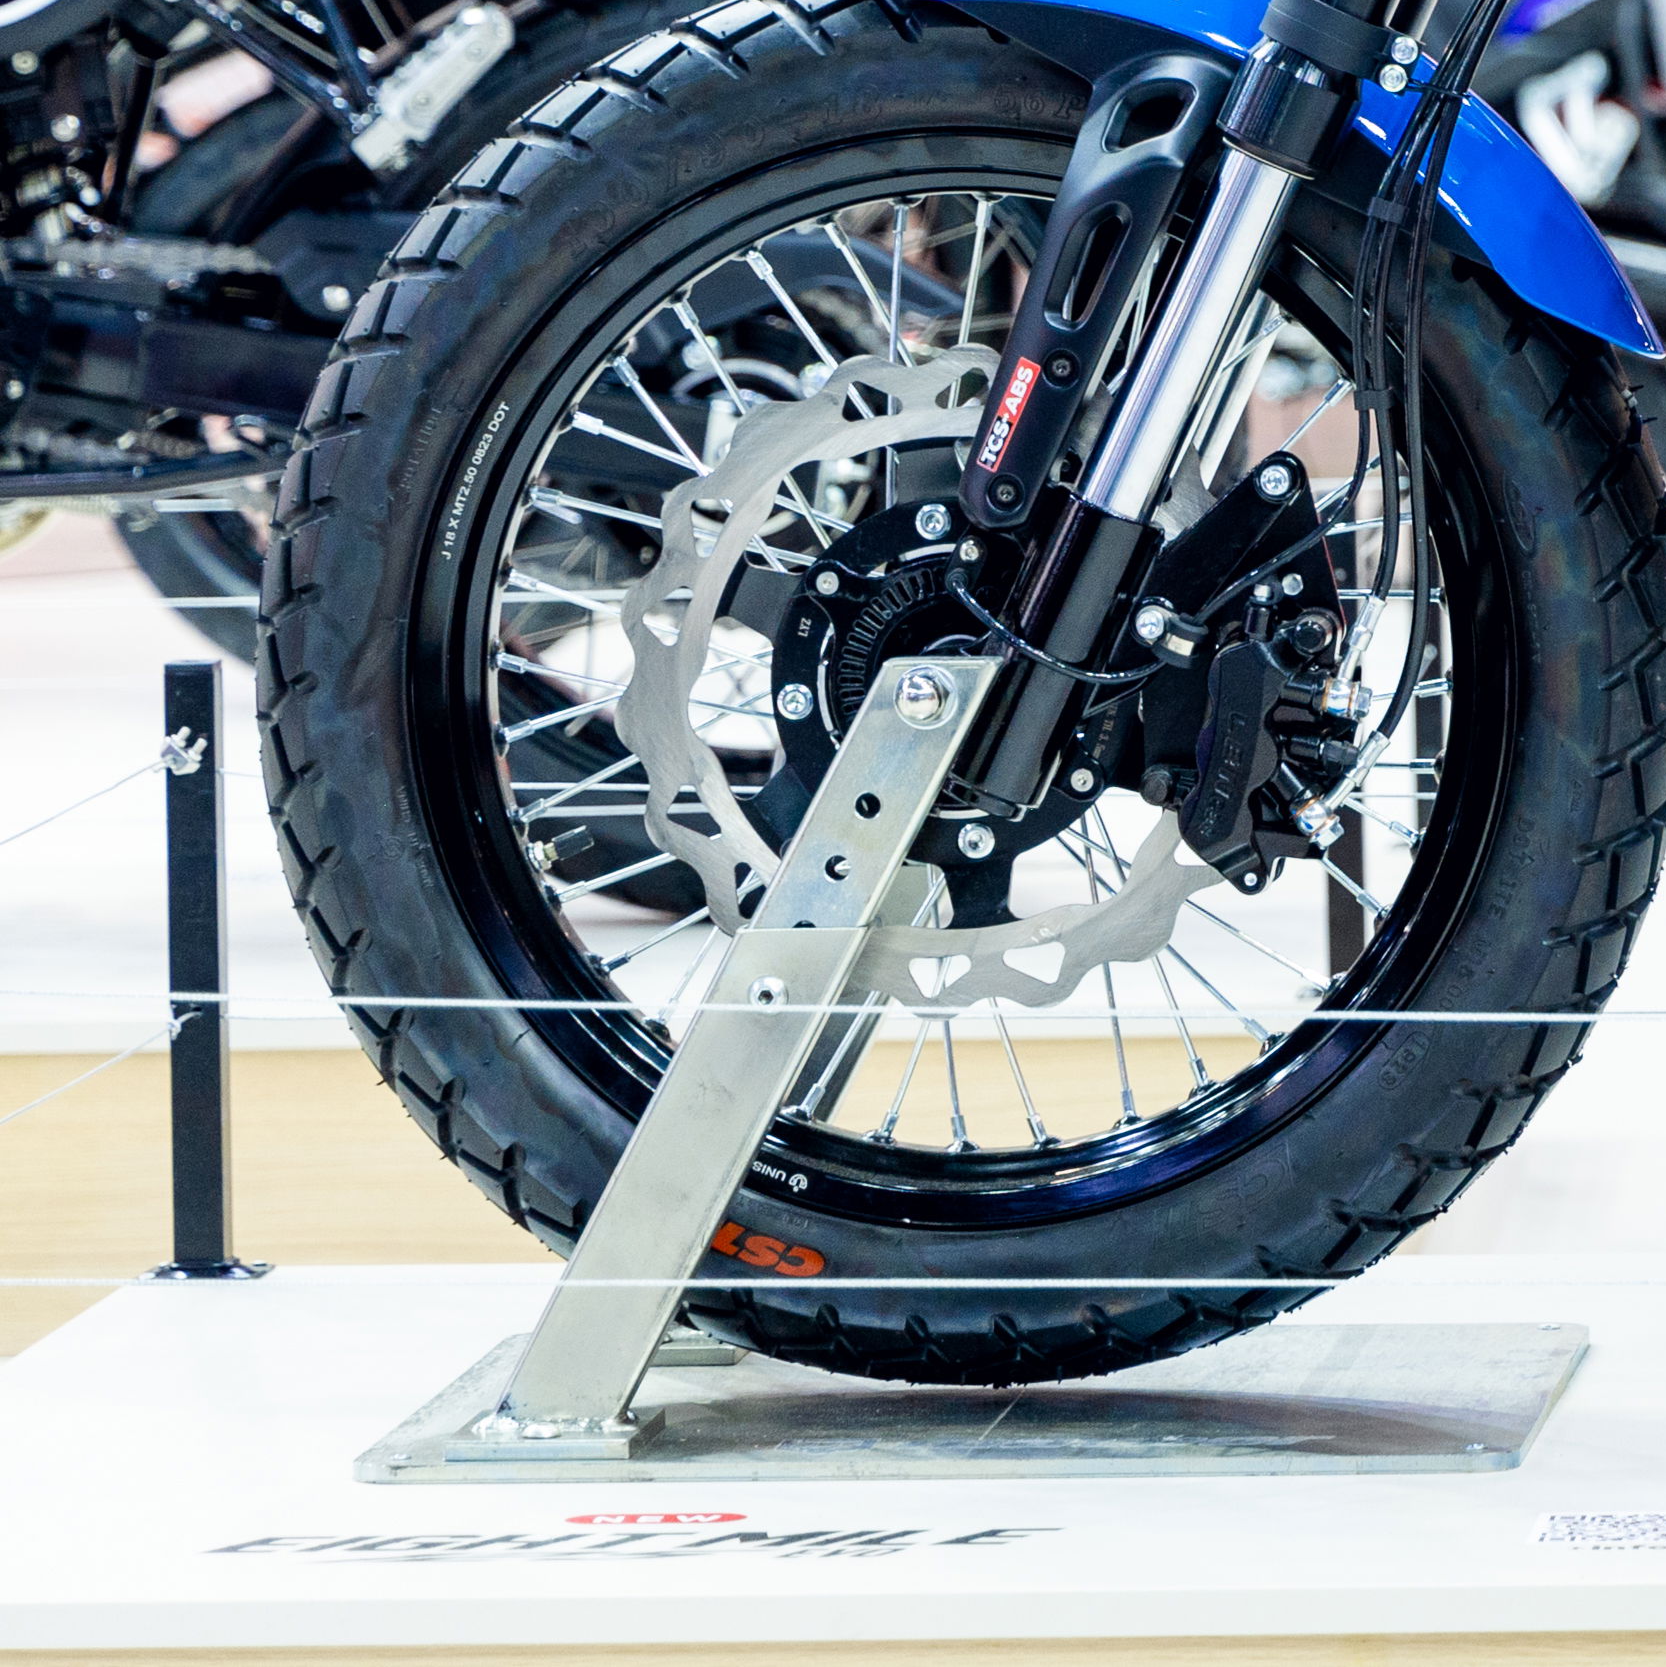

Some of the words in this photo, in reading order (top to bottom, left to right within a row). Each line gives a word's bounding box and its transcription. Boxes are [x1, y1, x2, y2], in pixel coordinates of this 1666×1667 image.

[488, 400, 511, 432] DOT
[471, 432, 493, 466] 0823
[452, 466, 478, 516] MT2.50
[448, 518, 460, 529] X
[443, 531, 456, 547] 18
[440, 551, 452, 560] J
[710, 1221, 826, 1278] CST
[593, 1513, 723, 1525] NEW
[202, 1532, 701, 1554] EIGHT
